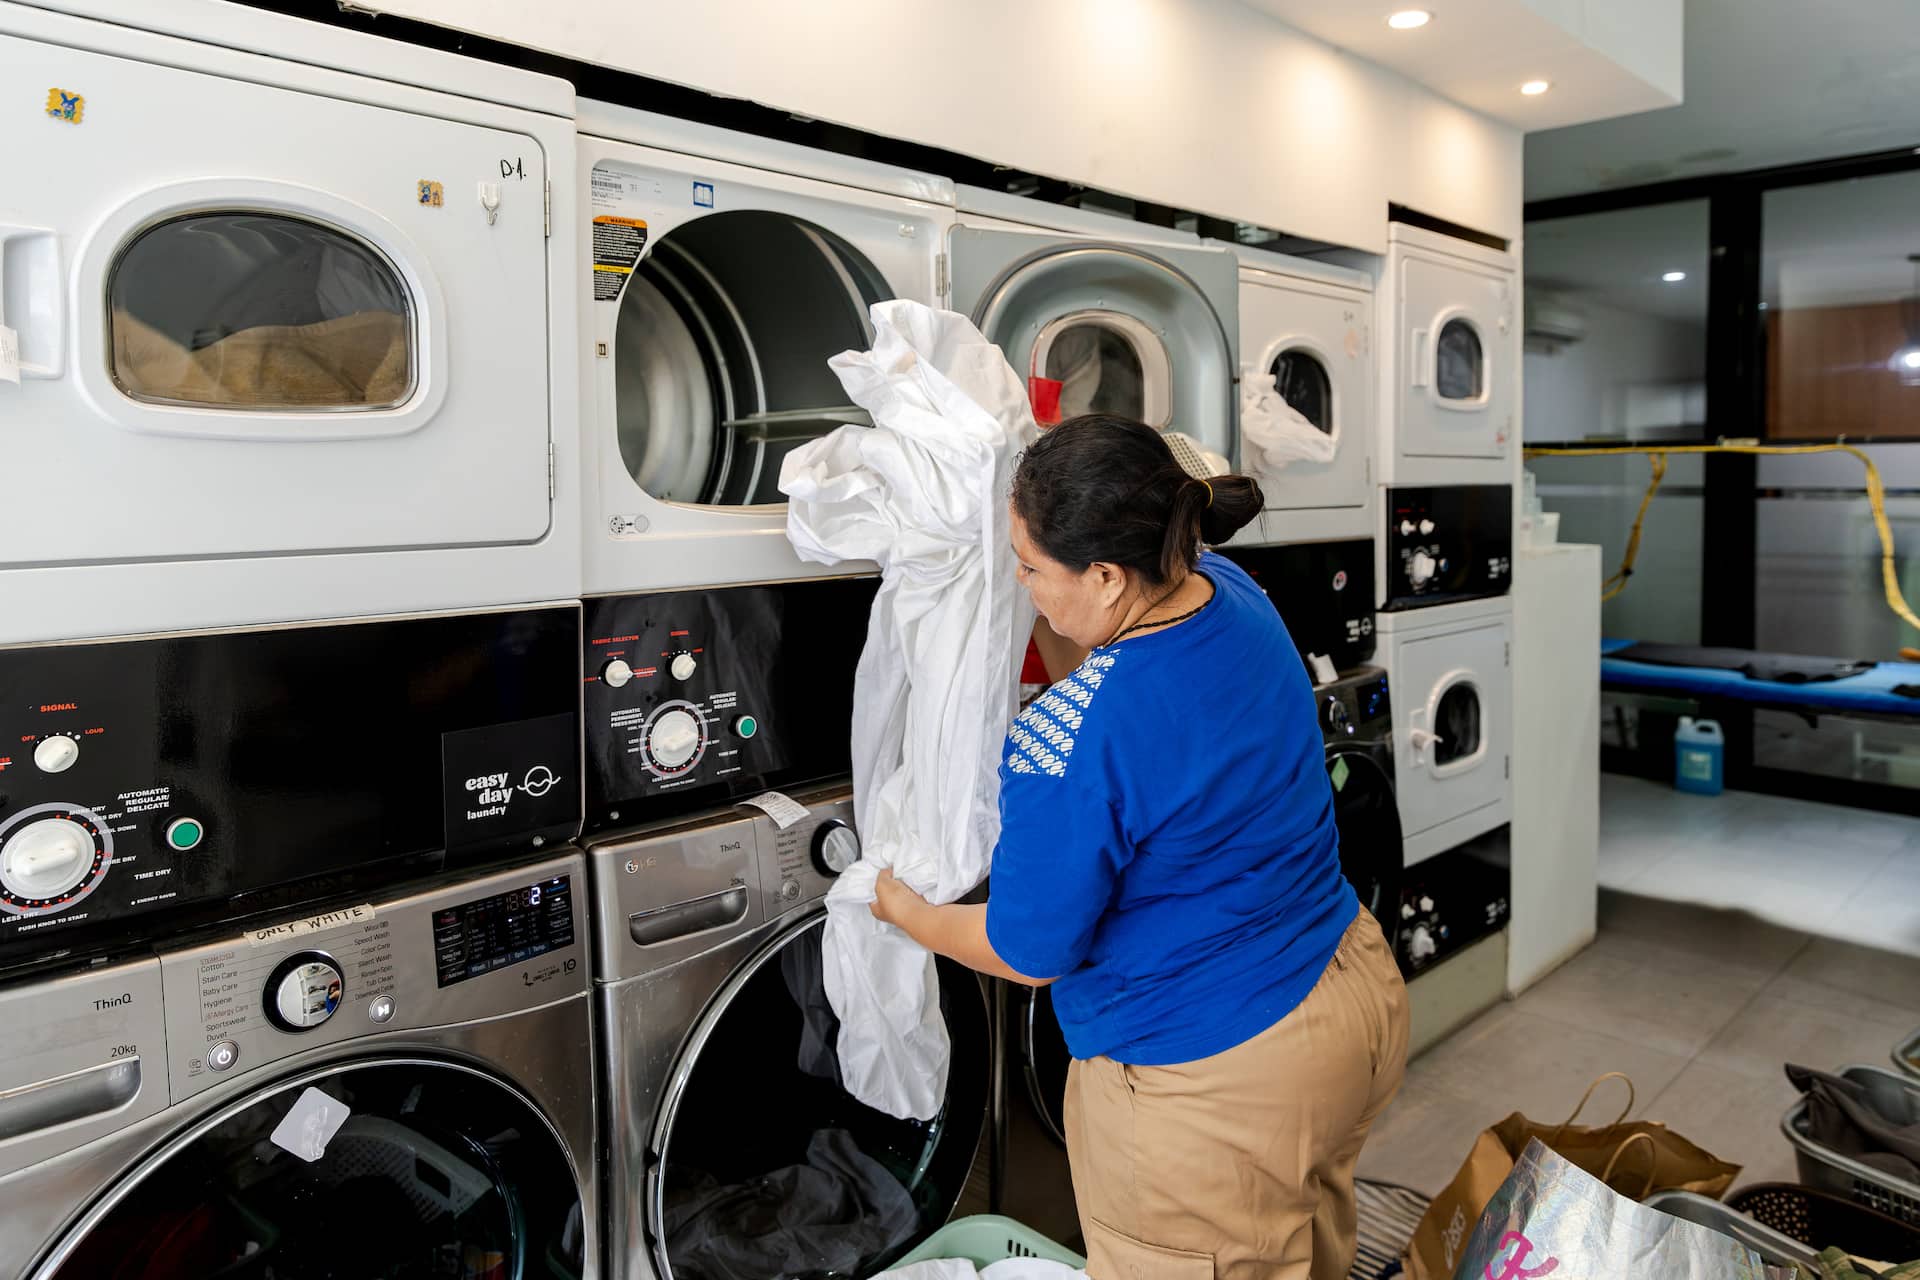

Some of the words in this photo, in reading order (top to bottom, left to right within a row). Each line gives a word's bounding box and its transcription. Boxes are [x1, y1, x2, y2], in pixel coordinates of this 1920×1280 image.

[40, 703, 78, 712] SIGNAL
[84, 727, 104, 735] LOUD
[465, 772, 509, 791] easy
[117, 787, 170, 800] AUTOMATIC
[125, 794, 170, 806] REGULAR/
[478, 787, 513, 805] day
[126, 801, 170, 814] DELICATE
[467, 805, 507, 820] laundry
[108, 812, 123, 820] DRY
[720, 842, 741, 853] ThinQ
[122, 855, 137, 863] DRY
[134, 871, 154, 880] TIME
[155, 868, 171, 877] DRY
[1, 915, 22, 923] LESS
[18, 923, 36, 932] PUSH
[38, 919, 57, 928] KNOB
[67, 913, 89, 921] START
[256, 923, 295, 940] ONLY
[305, 908, 363, 929] WHITE
[201, 962, 225, 973] Cotton
[202, 973, 221, 985] Stain
[221, 970, 238, 980] Care
[202, 987, 221, 997] Baby
[221, 982, 238, 992] Care
[93, 993, 133, 1011] ThinQ
[203, 996, 233, 1009] Hygiene
[206, 1016, 247, 1032] Sportswear
[206, 1031, 228, 1042] Duvet
[111, 1044, 137, 1057] 20kg
